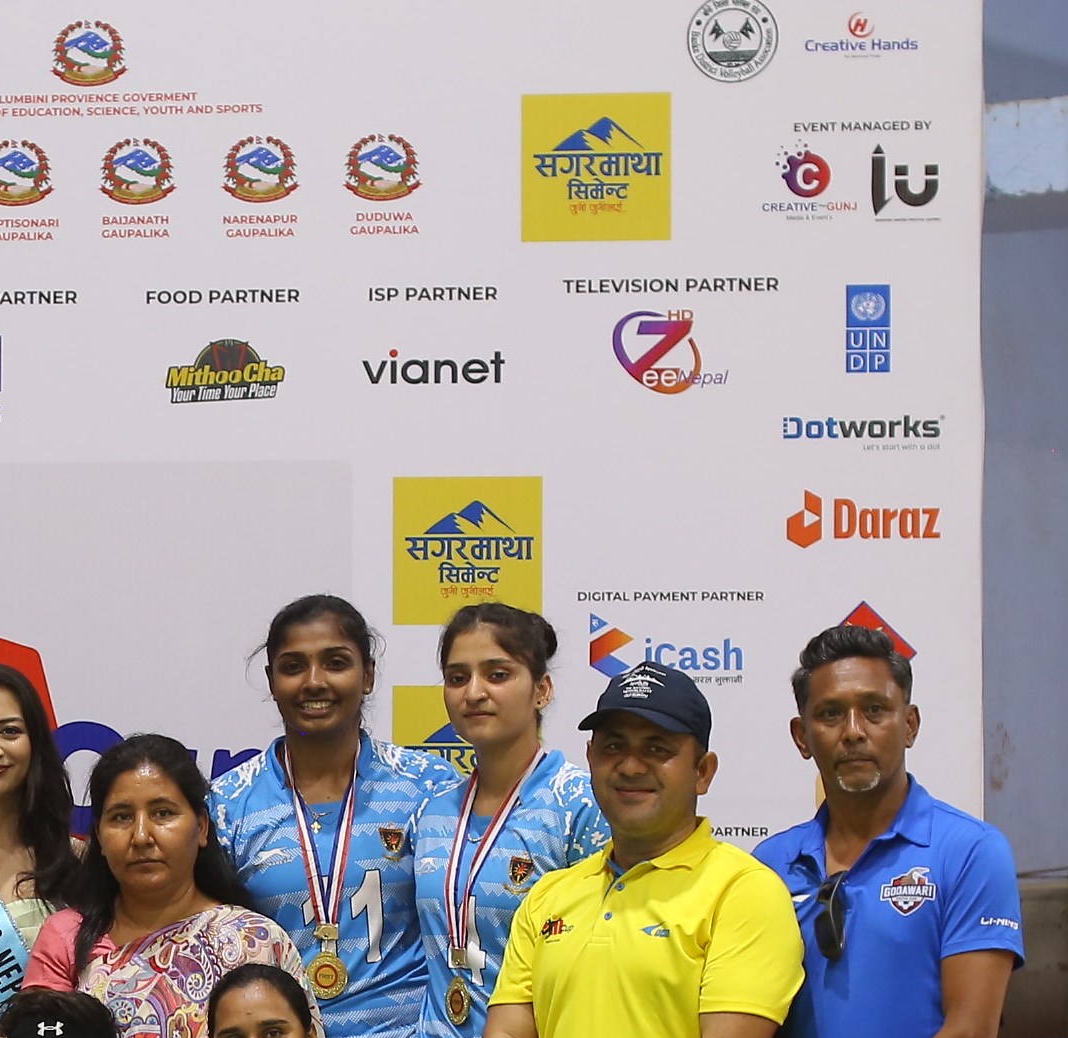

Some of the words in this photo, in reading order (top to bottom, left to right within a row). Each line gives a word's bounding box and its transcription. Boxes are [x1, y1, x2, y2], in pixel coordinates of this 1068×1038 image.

[805, 38, 867, 52] Creative
[871, 38, 919, 51] Hands
[0, 94, 48, 104] LUMBINI
[52, 93, 119, 103] PROVIENCE
[122, 91, 198, 102] GOVERMENT
[12, 107, 83, 119] EDUCATION,
[87, 106, 139, 118] SCIENCE,
[143, 105, 184, 115] YOUTH
[187, 104, 213, 115] AND
[217, 103, 263, 114] SPORTS
[793, 122, 837, 132] EVENT
[841, 120, 911, 132] MANAGED
[914, 120, 932, 131] BY
[533, 152, 663, 178] सगरमाथा
[567, 178, 629, 200] सिमेन्ट
[762, 202, 818, 212] CREATIVE
[826, 201, 858, 211] GUNJ
[102, 215, 169, 226] BAIJANATH
[223, 214, 298, 225] NARENAPUR
[356, 211, 414, 222] DUDUWA
[101, 229, 170, 240] GAUPALIKA
[226, 227, 294, 238] GAUPALIKA
[350, 225, 420, 236] GAUPALIKA
[563, 279, 681, 294] TELEVISION
[686, 277, 779, 293] PARTNER
[146, 289, 203, 305] FOOD
[209, 288, 300, 304] PARTNER
[369, 287, 399, 302] ISP
[405, 286, 497, 301] PARTNER
[362, 349, 506, 385] vianet
[171, 387, 195, 402] Your
[197, 386, 221, 401] Time
[223, 385, 246, 400] Your
[248, 384, 277, 399] Place
[783, 415, 941, 439] Dotworks
[833, 498, 941, 539] Daraz
[405, 536, 534, 561] सगरमाथा
[438, 561, 500, 584] सिमेन्ट
[577, 591, 629, 602] DIGITAL
[634, 591, 698, 602] PAYMENT
[702, 590, 764, 601] PARTNER
[645, 638, 743, 671] iCash
[884, 885, 933, 898] GODAWARI
